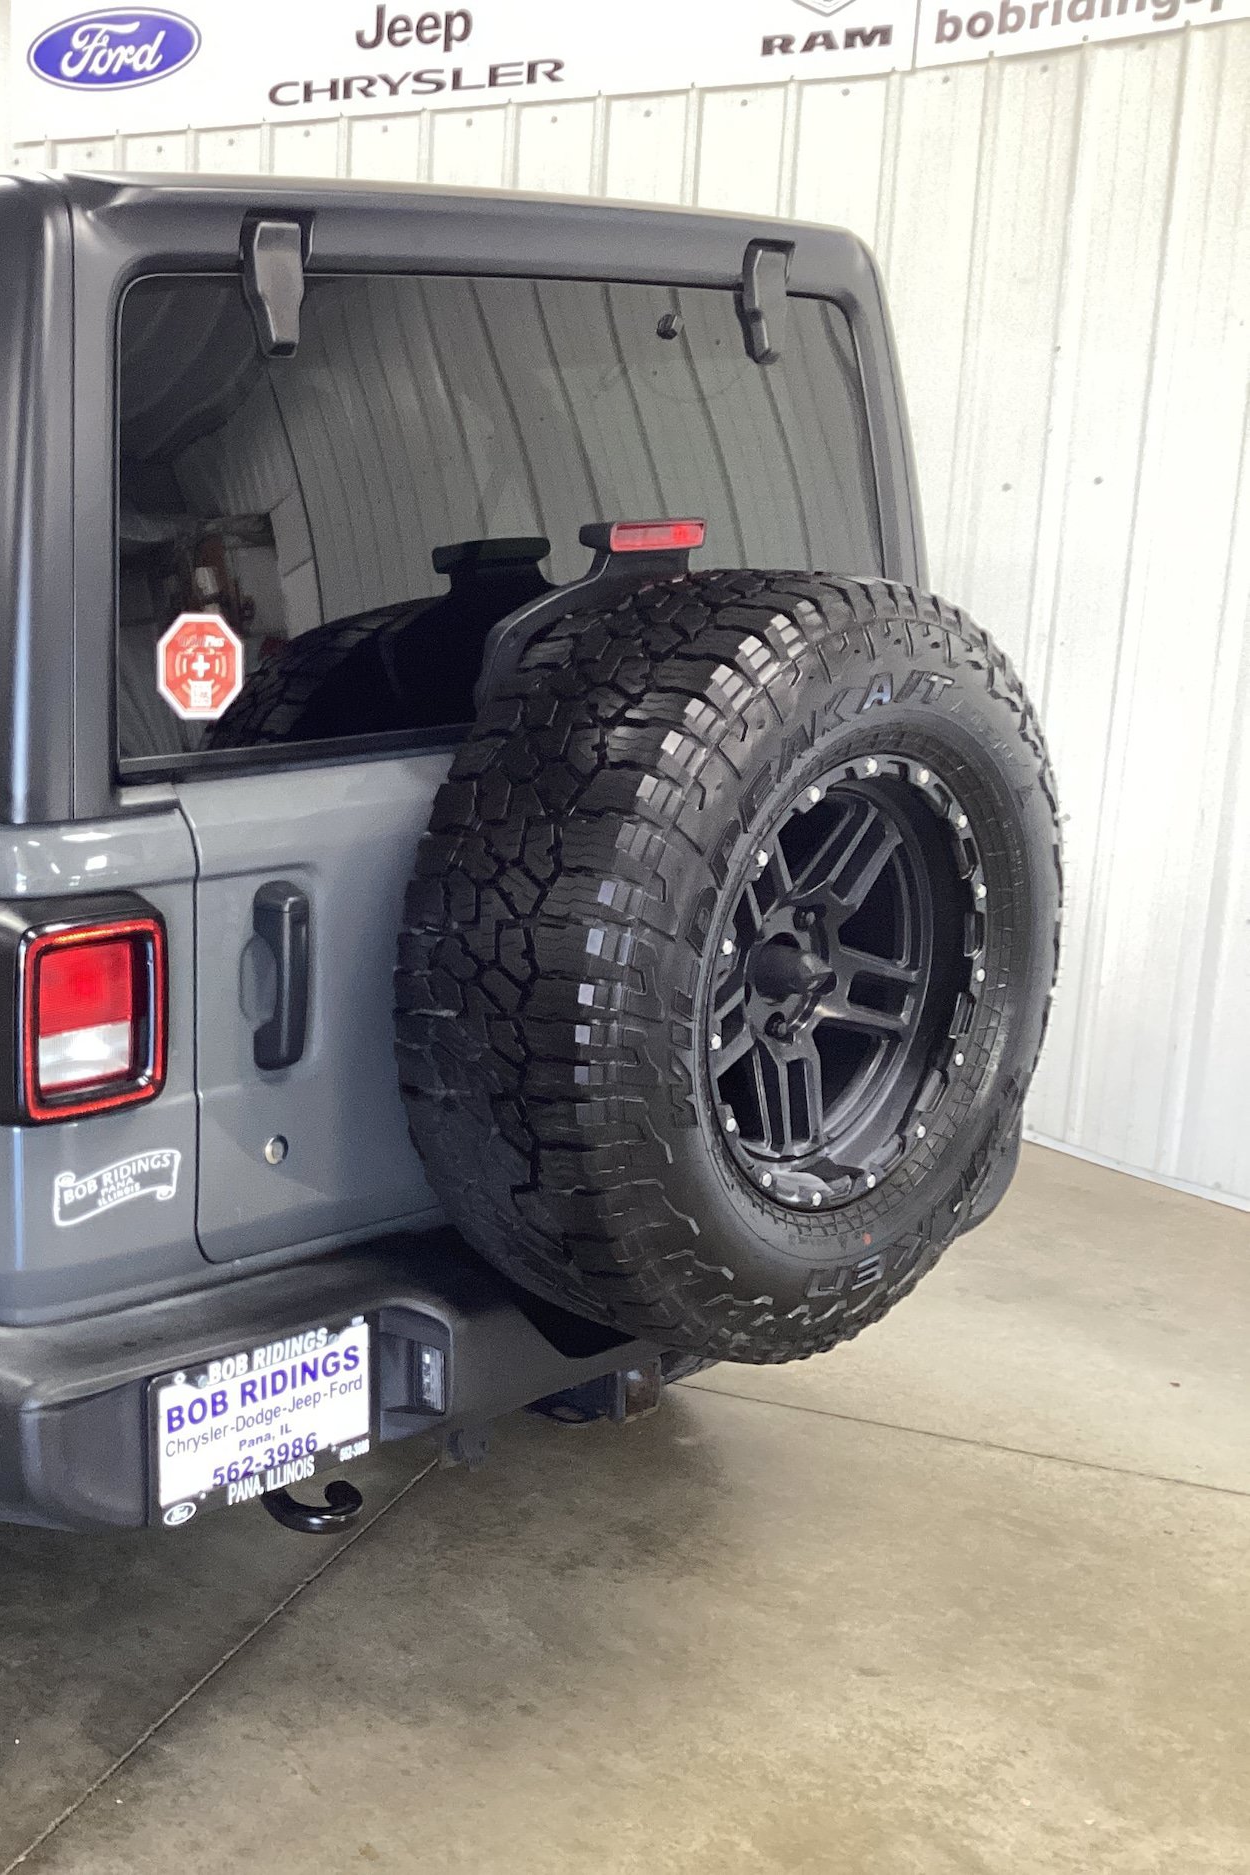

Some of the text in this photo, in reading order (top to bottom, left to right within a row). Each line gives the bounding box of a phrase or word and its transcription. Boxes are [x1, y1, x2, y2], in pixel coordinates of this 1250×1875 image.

[60, 20, 165, 77] Ford
[354, 4, 473, 53] Jeep
[760, 24, 894, 58] RAM
[267, 58, 566, 107] CHRYSLER
[63, 1153, 171, 1205] BOB RIDINGS
[101, 1176, 134, 1197] PANA
[207, 1327, 328, 1386] BOB RIDINGS
[166, 1345, 360, 1434] BOB RIDINGS
[212, 1432, 318, 1487] 562-3986
[238, 1423, 292, 1452] Pana, IL
[266, 1455, 316, 1492] ILLINOIS
